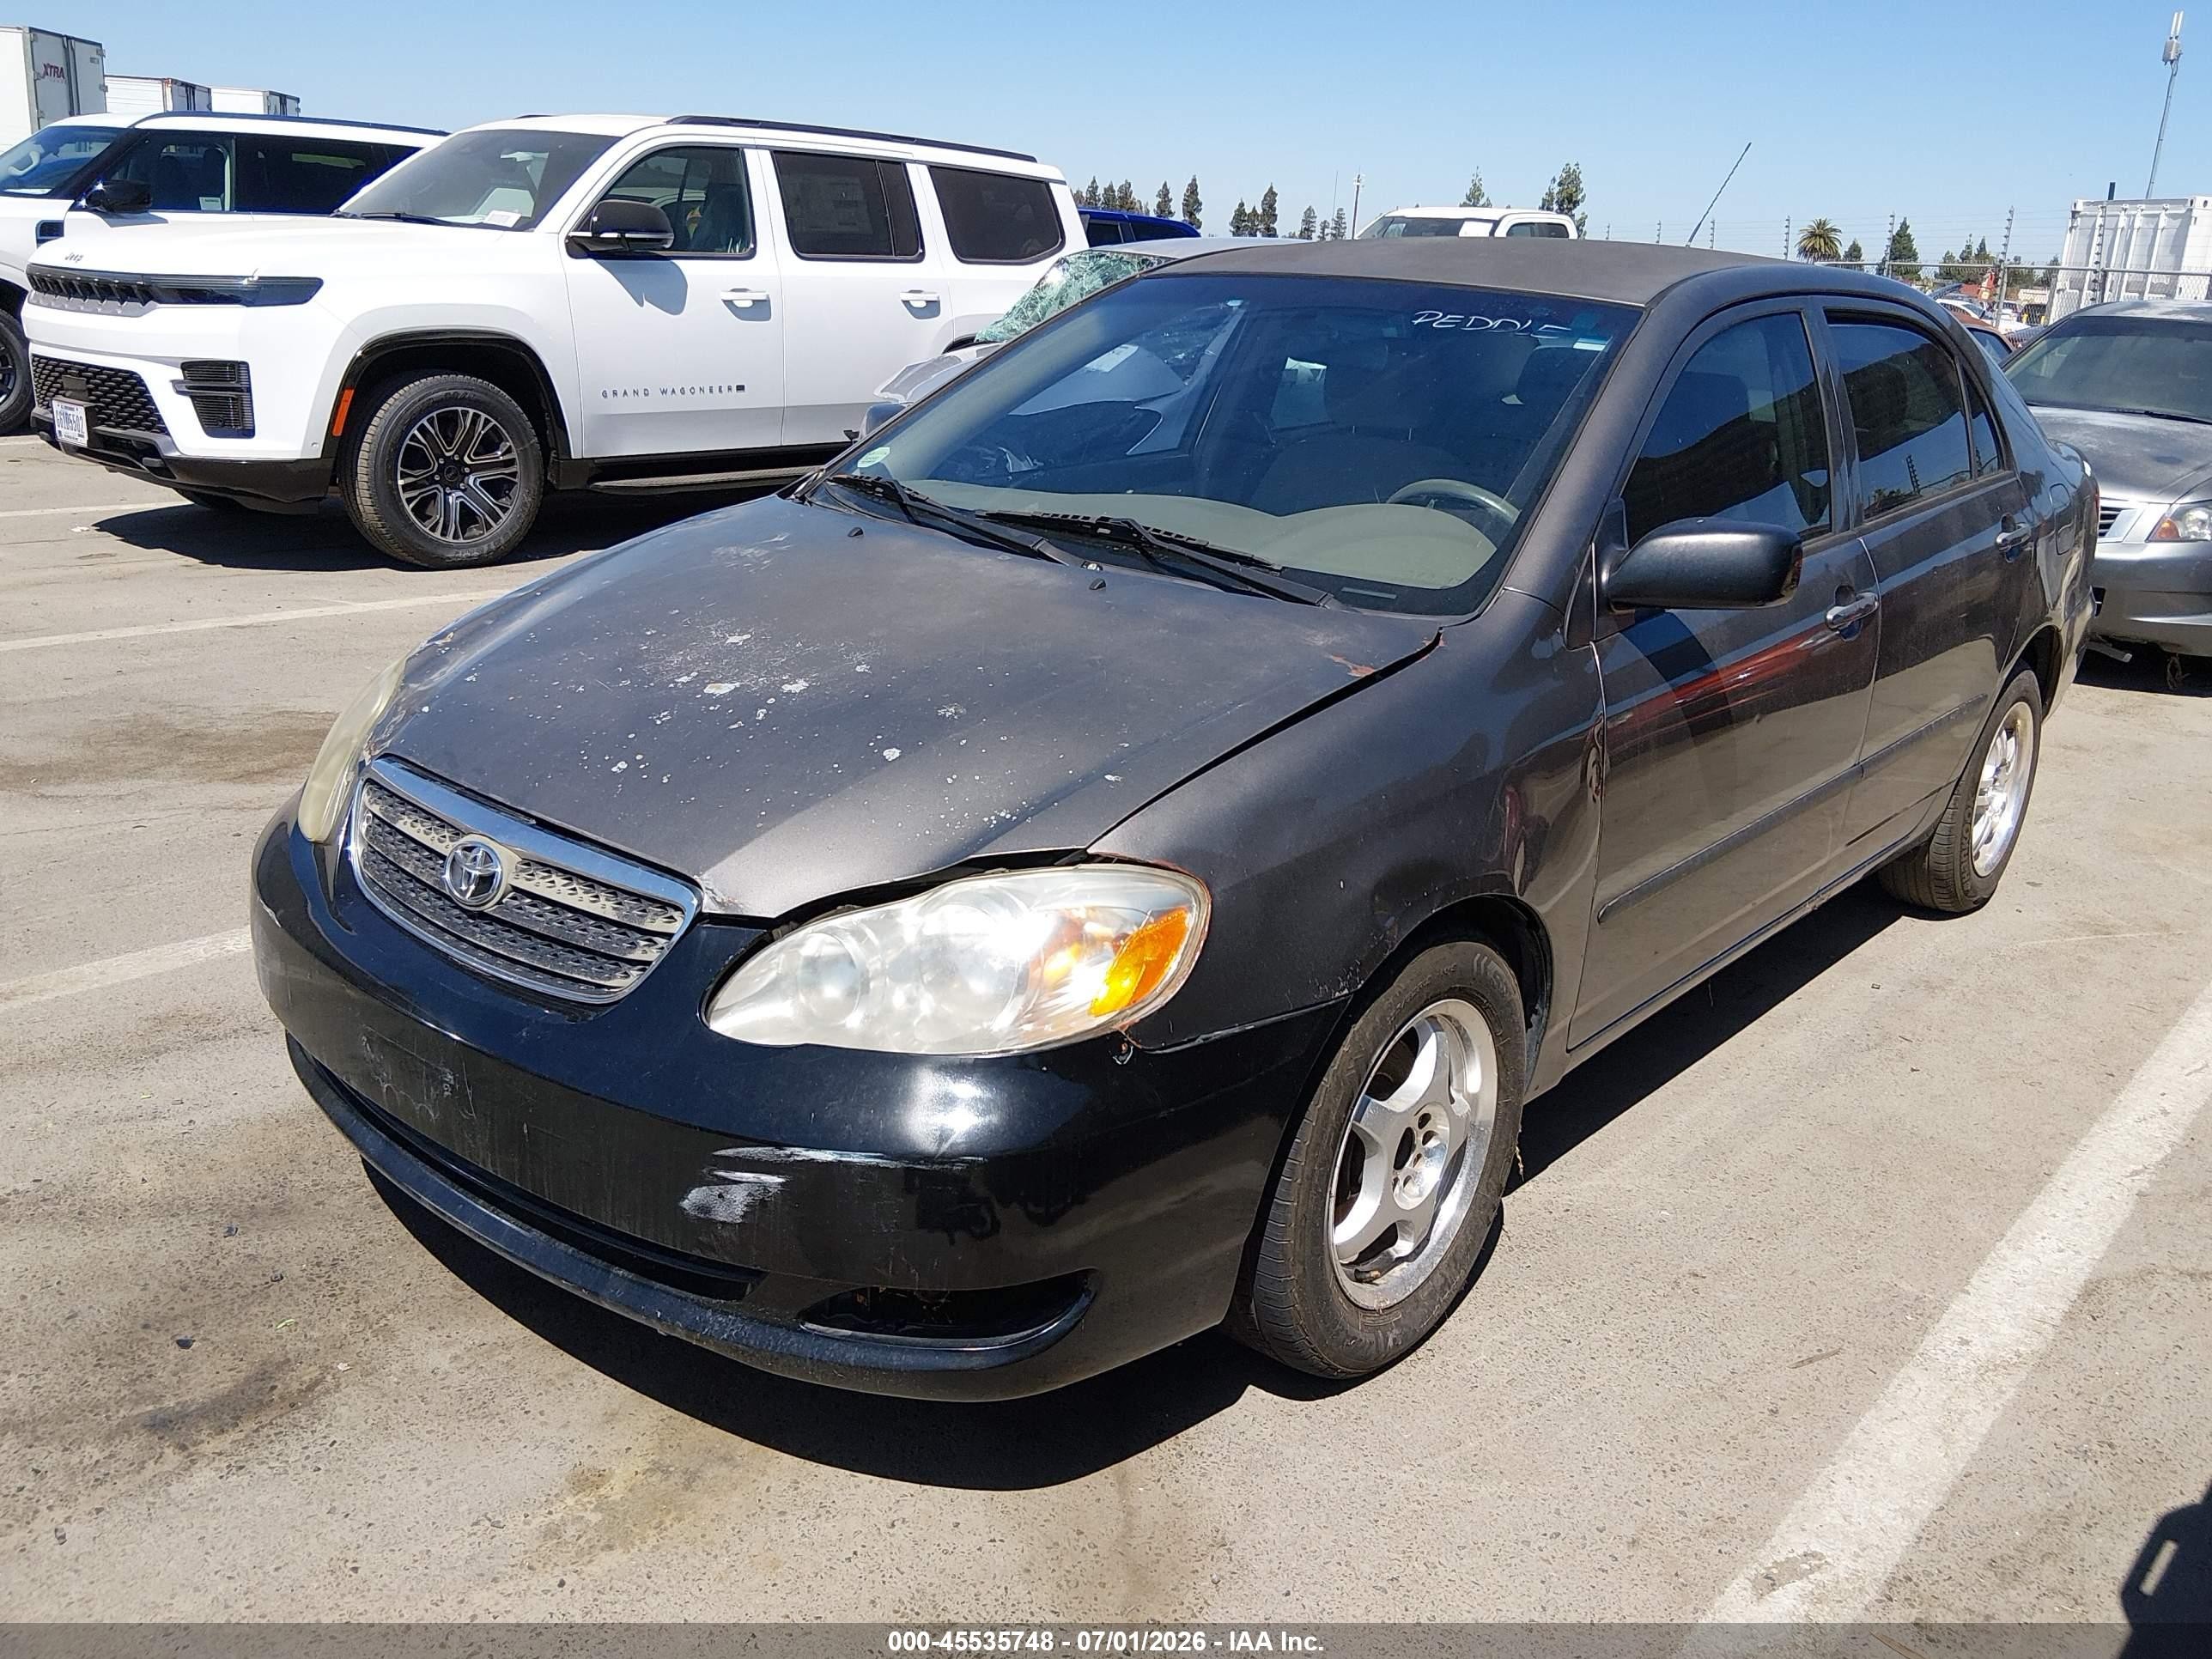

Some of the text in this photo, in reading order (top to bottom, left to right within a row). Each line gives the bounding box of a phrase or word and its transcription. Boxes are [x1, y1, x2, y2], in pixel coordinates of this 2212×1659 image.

[42, 63, 65, 79] XTRA
[1412, 310, 1572, 339] PEDDLE
[601, 386, 732, 399] GRAND WAGONEER
